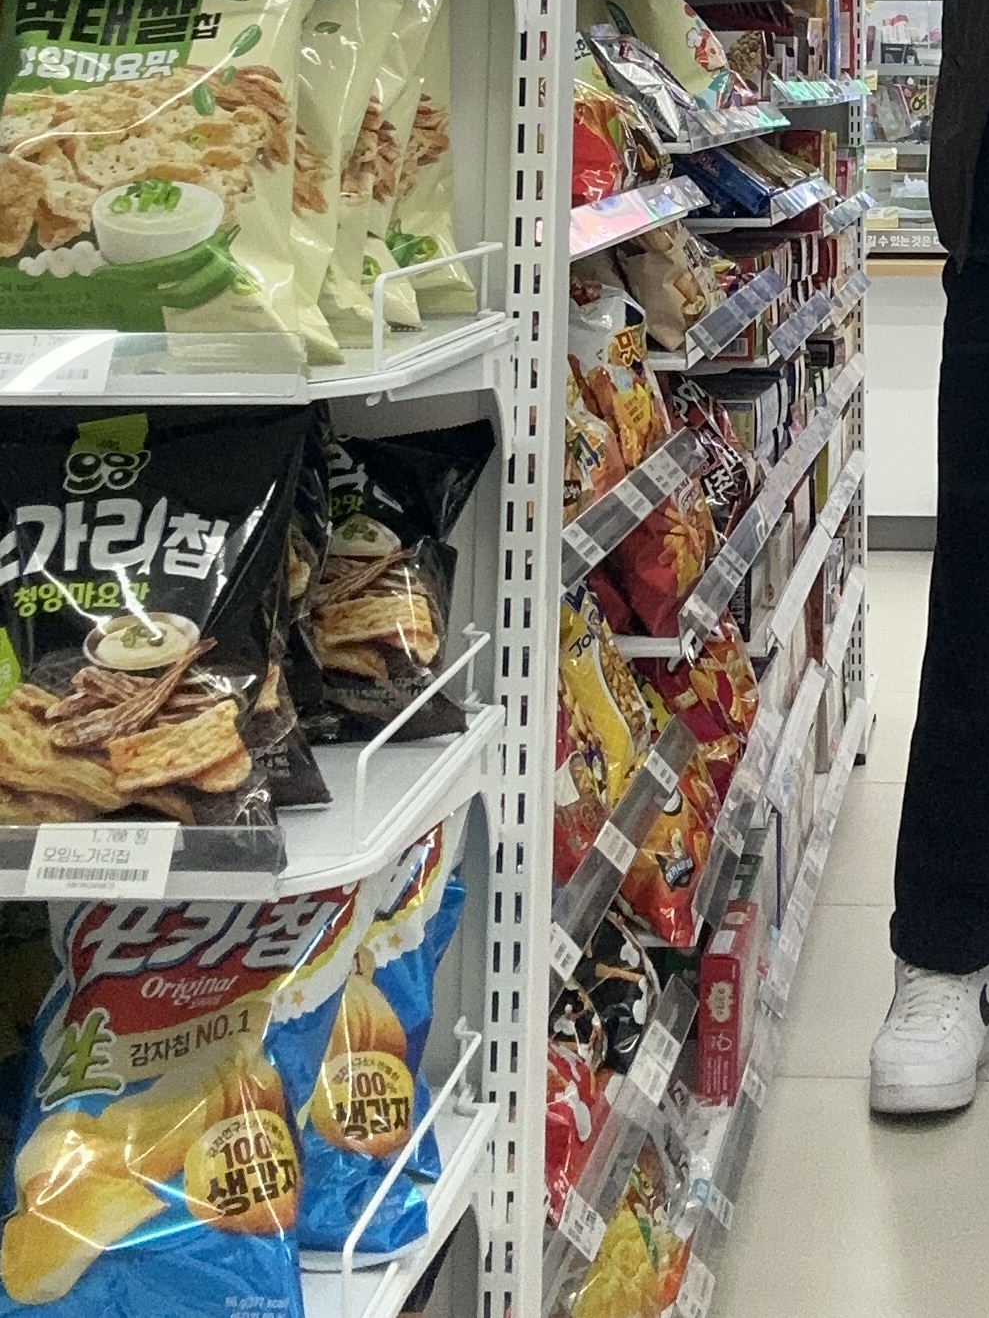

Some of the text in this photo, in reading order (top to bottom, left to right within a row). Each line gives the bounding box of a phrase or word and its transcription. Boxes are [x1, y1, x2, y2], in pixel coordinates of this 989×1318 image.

[890, 235, 910, 248] 있는
[911, 235, 932, 248] 것은
[141, 975, 239, 1006] Original
[129, 1009, 251, 1068] 감자칩 NO.1
[206, 1158, 297, 1216] 생감자
